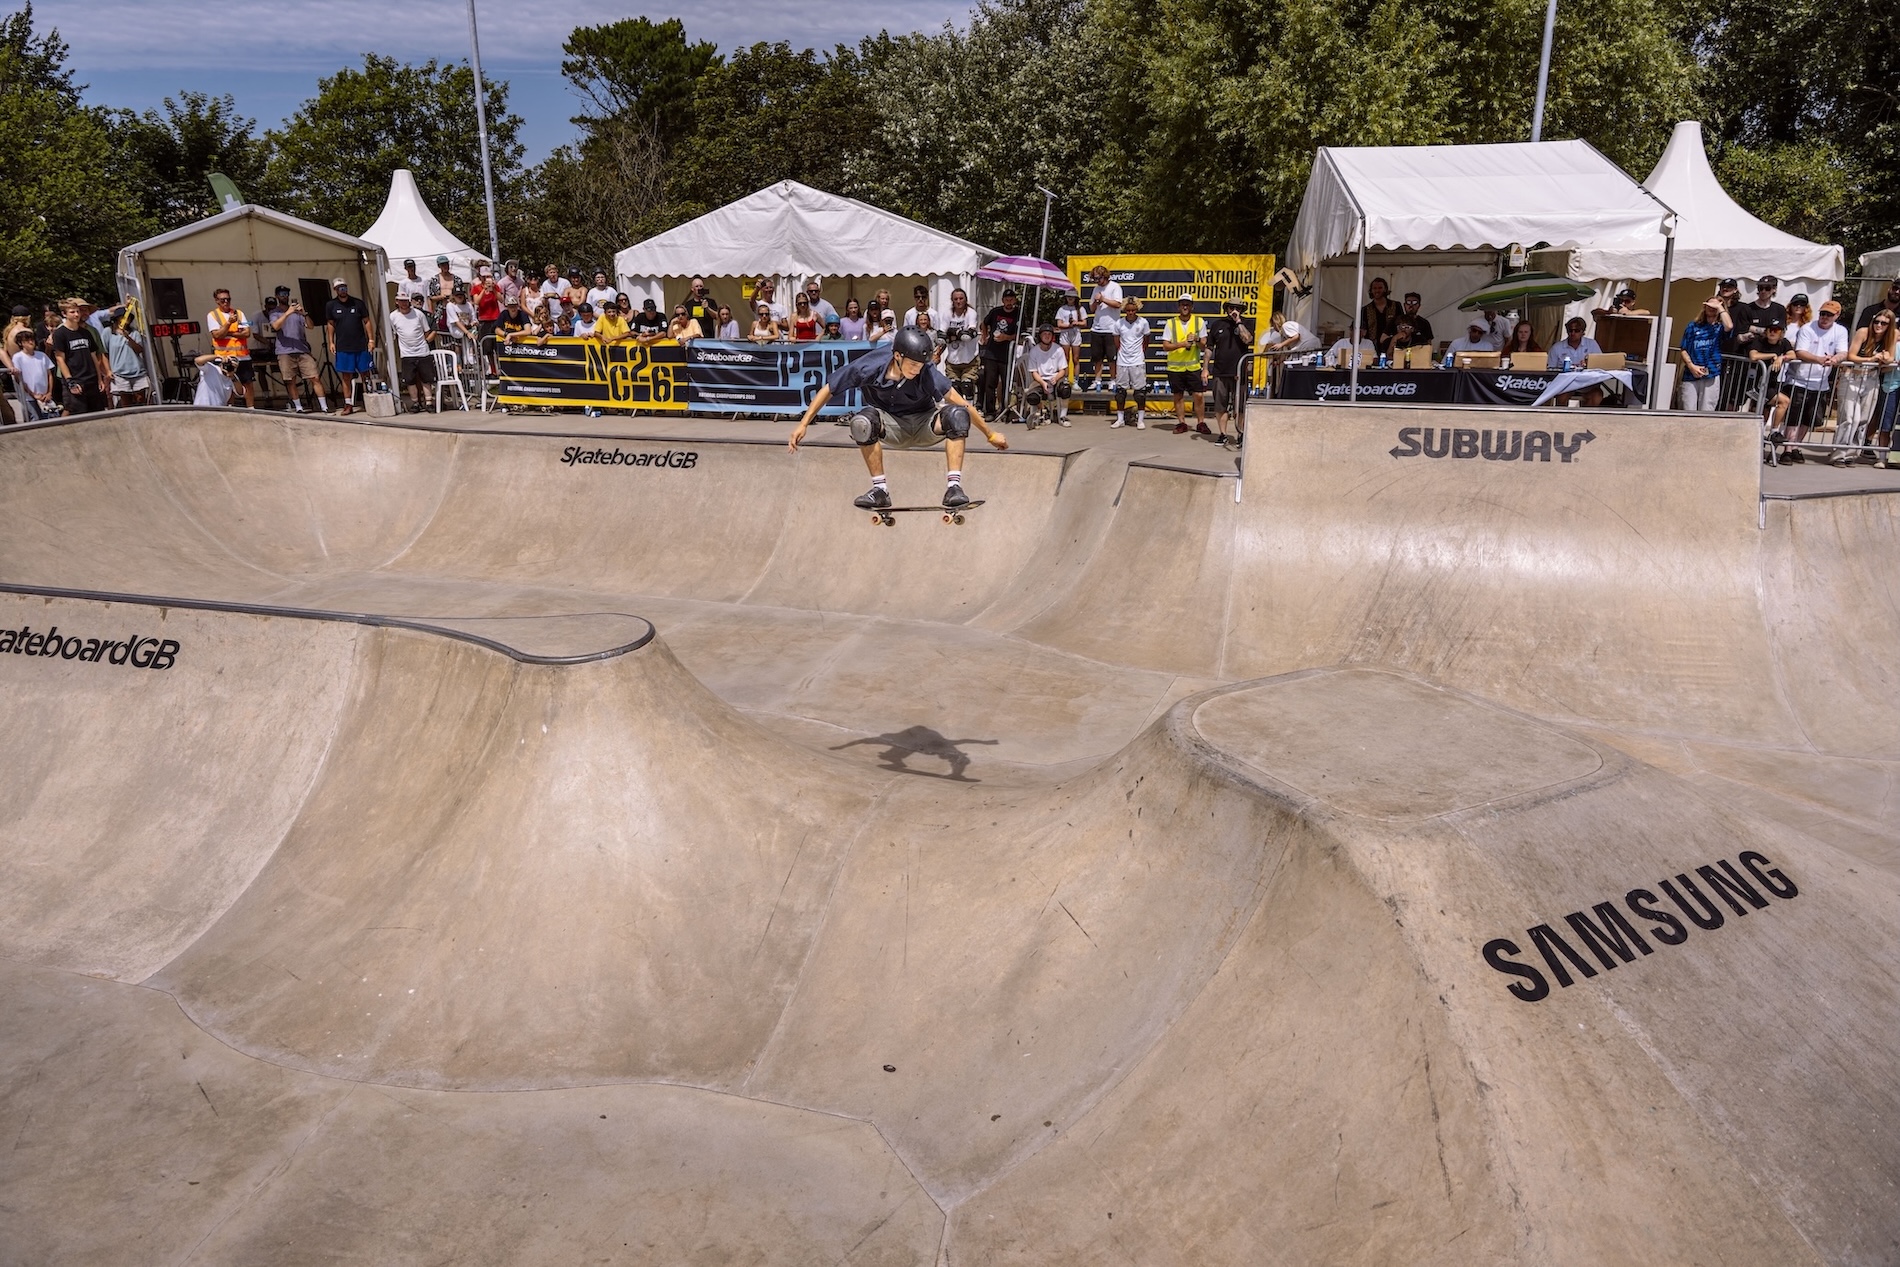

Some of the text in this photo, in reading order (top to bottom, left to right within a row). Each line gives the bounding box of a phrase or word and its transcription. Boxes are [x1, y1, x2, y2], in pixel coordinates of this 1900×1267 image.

[504, 345, 558, 357] SkateboardGB
[696, 351, 754, 363] SkateboardGB
[1388, 426, 1597, 463] SUBWAY
[560, 446, 699, 469] SkateboardGB
[1482, 850, 1799, 1002] SAMSUNG
